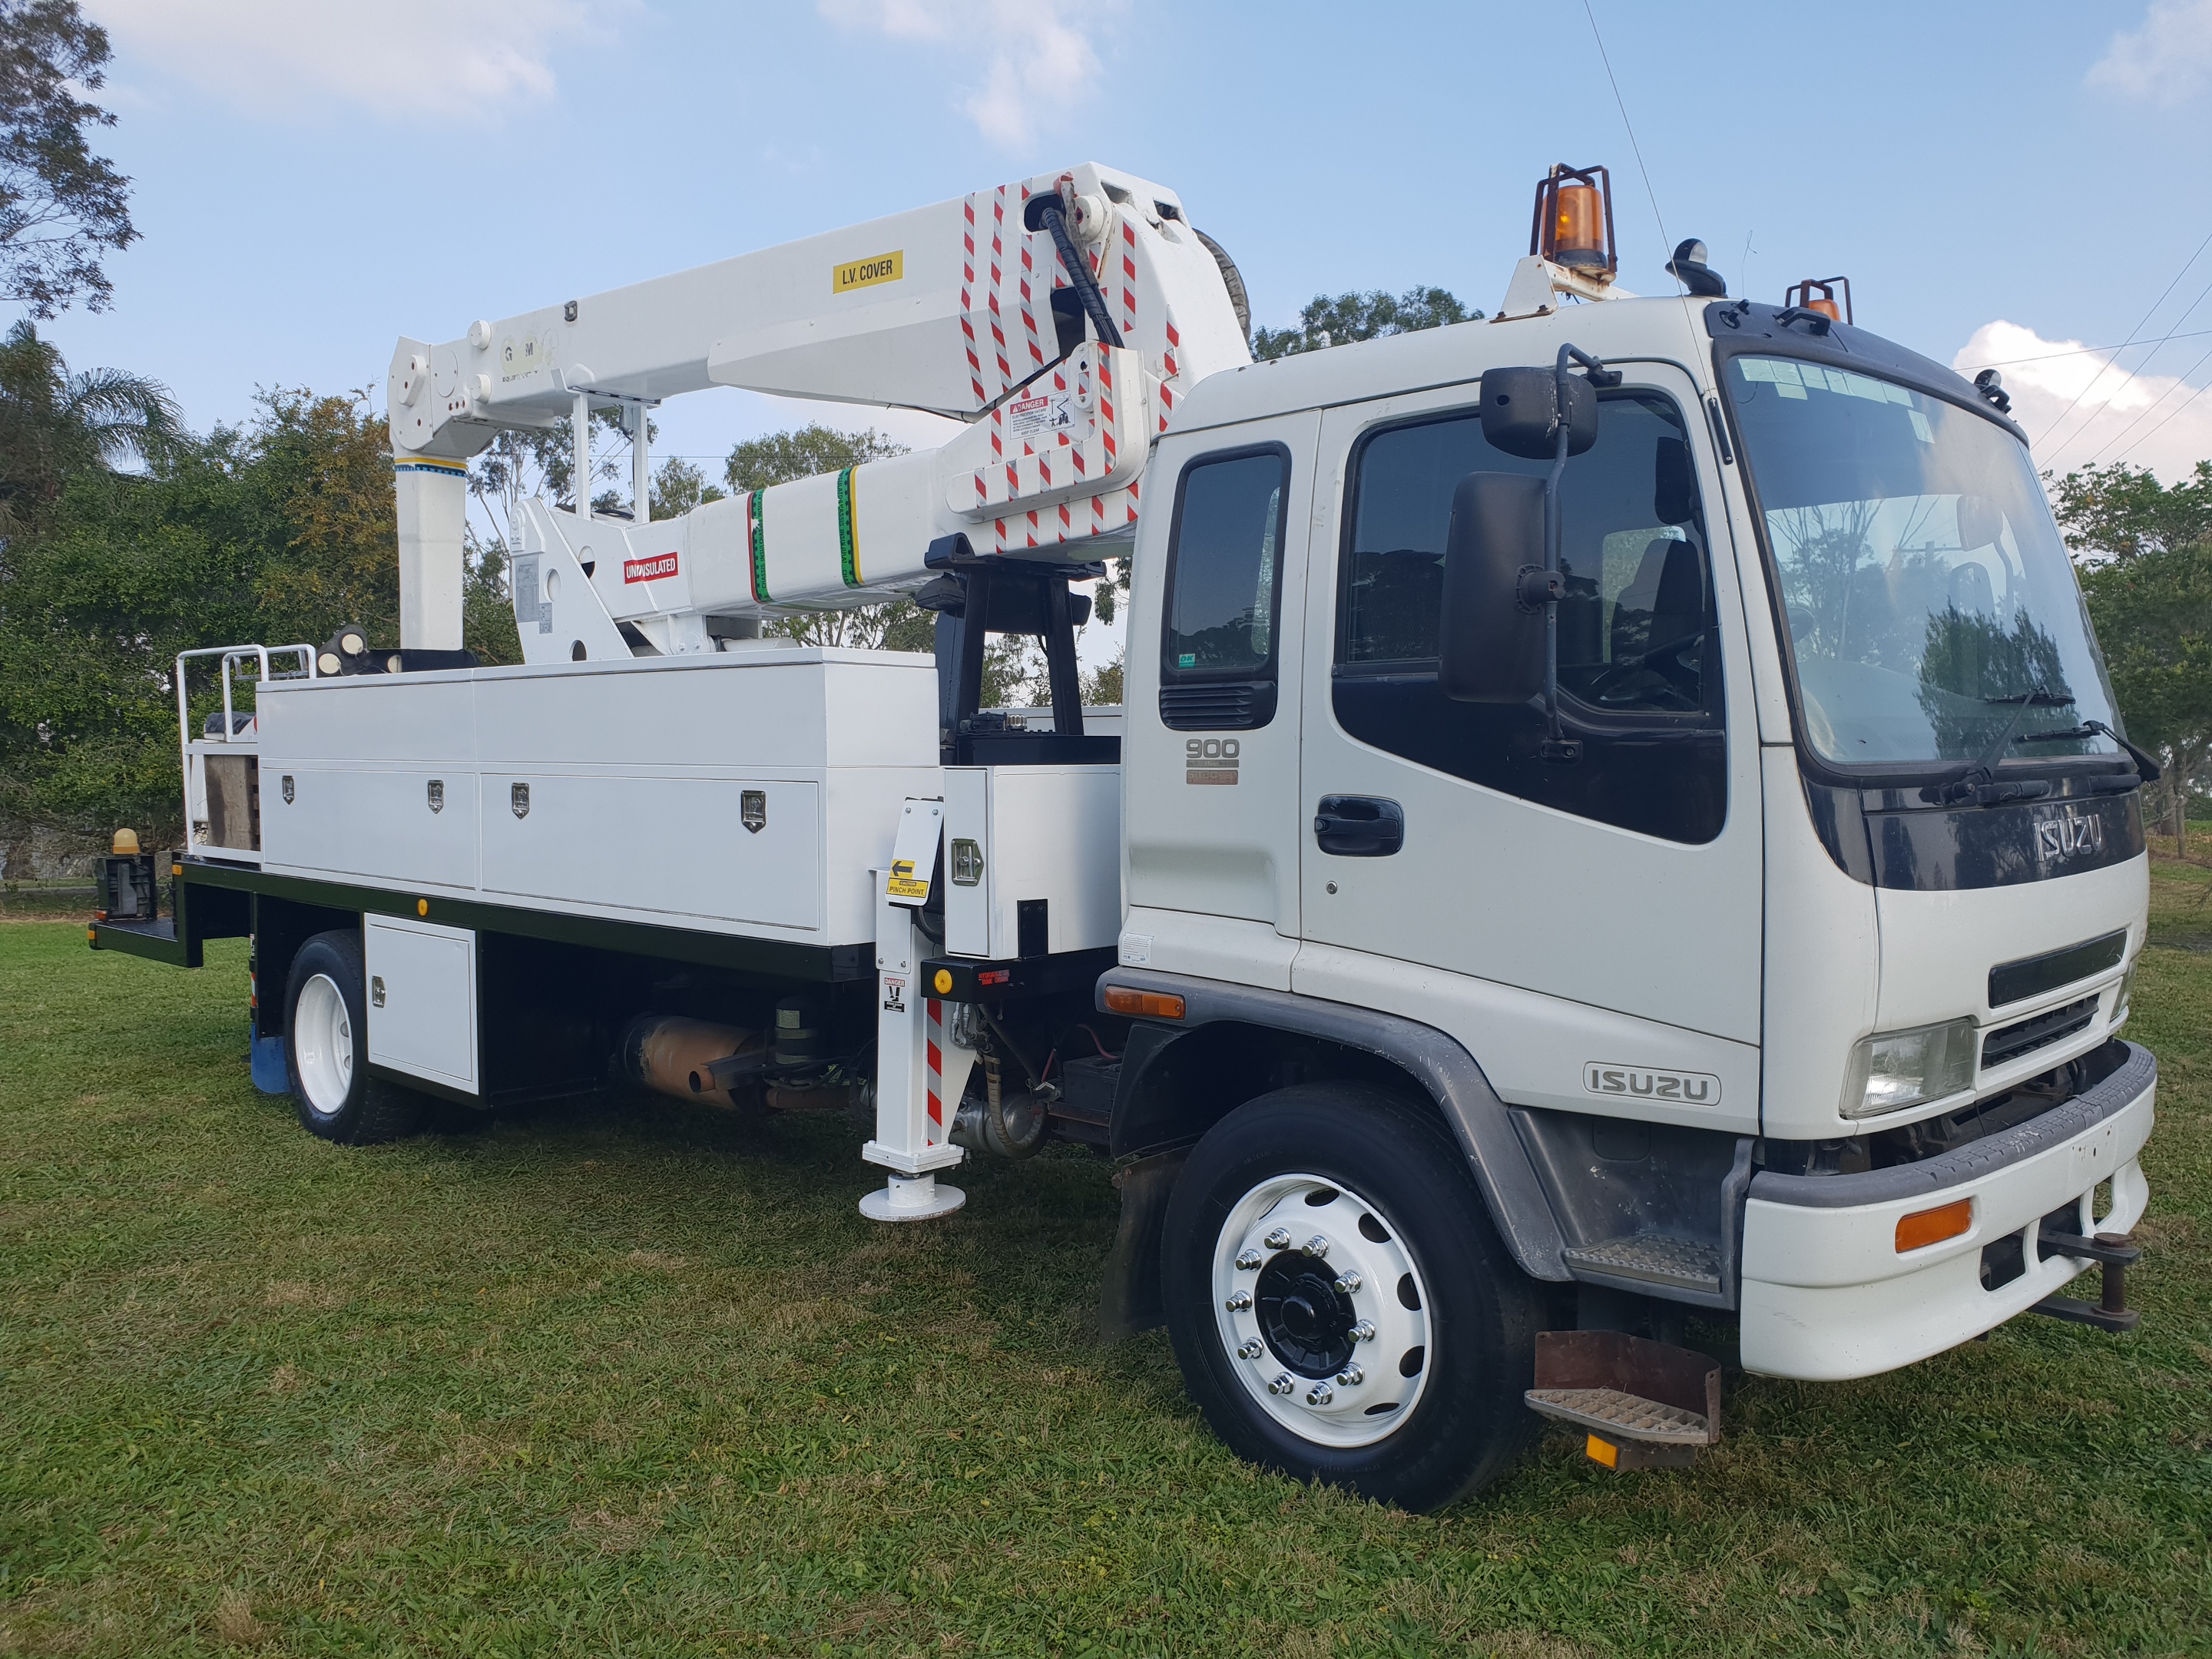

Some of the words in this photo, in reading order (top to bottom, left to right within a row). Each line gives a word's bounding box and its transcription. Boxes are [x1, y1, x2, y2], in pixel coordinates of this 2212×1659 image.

[843, 267, 857, 285] L.V.
[859, 259, 892, 281] COVER
[1017, 399, 1044, 412] DANGER
[626, 558, 676, 579] UNINSULATED
[1186, 738, 1240, 759] 900
[2032, 813, 2104, 862] ISUZU
[885, 978, 905, 987] DANGER
[1591, 1069, 1708, 1101] ISUZU
